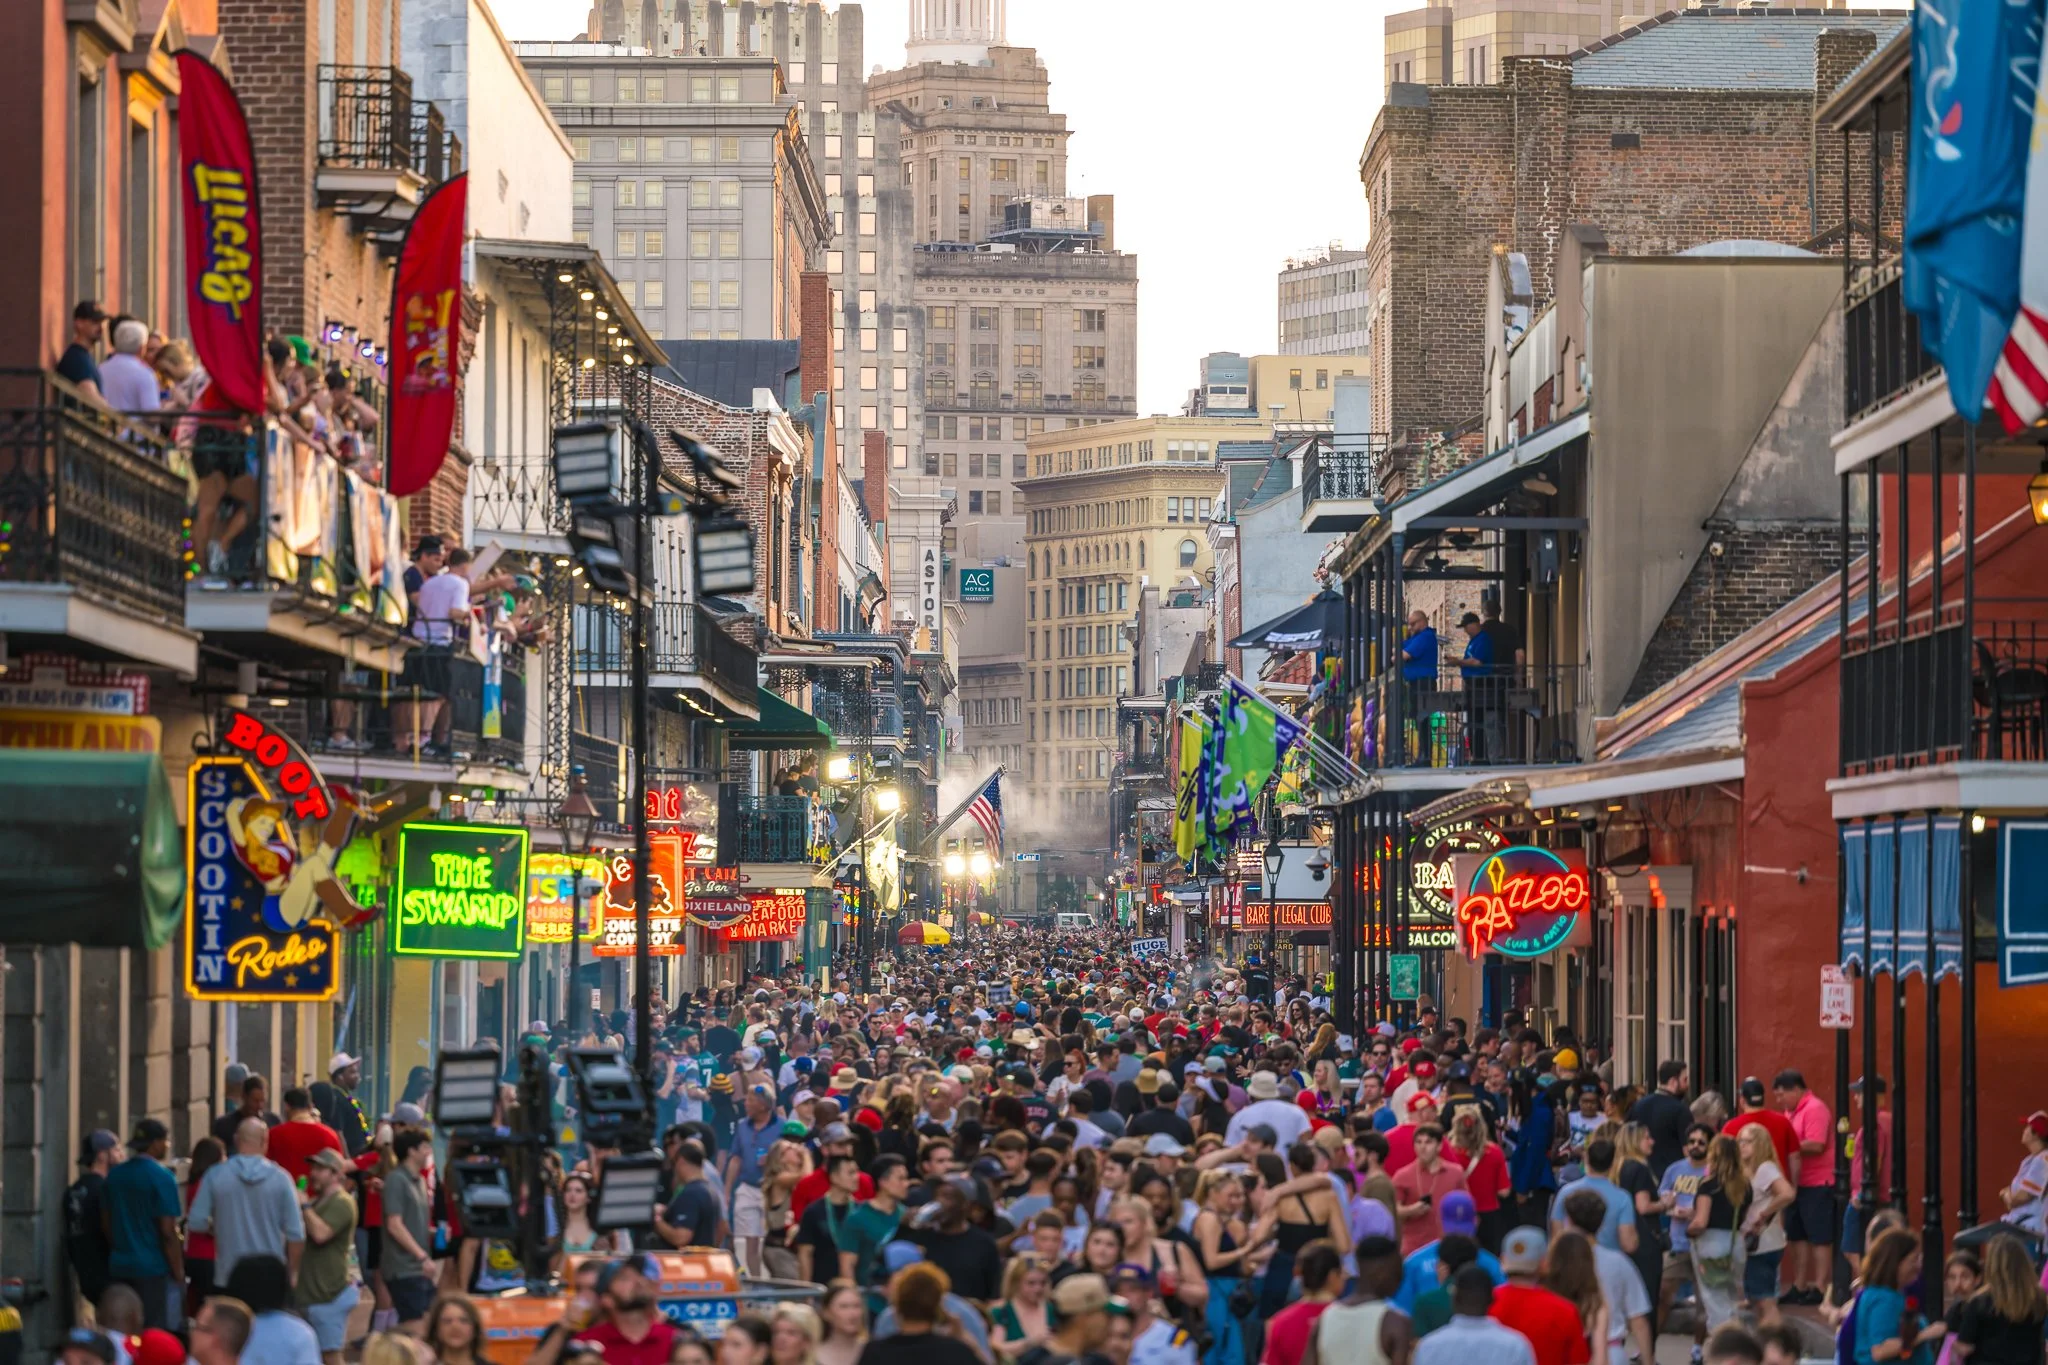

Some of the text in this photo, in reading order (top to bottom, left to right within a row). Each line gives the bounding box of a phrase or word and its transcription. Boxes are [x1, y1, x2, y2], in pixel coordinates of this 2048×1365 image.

[924, 549, 935, 628] ASTOR
[965, 573, 989, 586] AC
[225, 712, 328, 820] BOOT
[196, 771, 227, 983] SCOOTIN
[431, 853, 492, 888] THE
[402, 889, 519, 929] SWAMP
[775, 896, 805, 907] 424
[1246, 905, 1280, 925] BAREY
[1281, 904, 1309, 925] LEGAL
[1310, 904, 1332, 924] CLUB
[743, 919, 806, 938] MARKET
[1132, 940, 1168, 952] HUGE
[227, 933, 327, 988] Rodeo
[702, 1068, 712, 1088] 7
